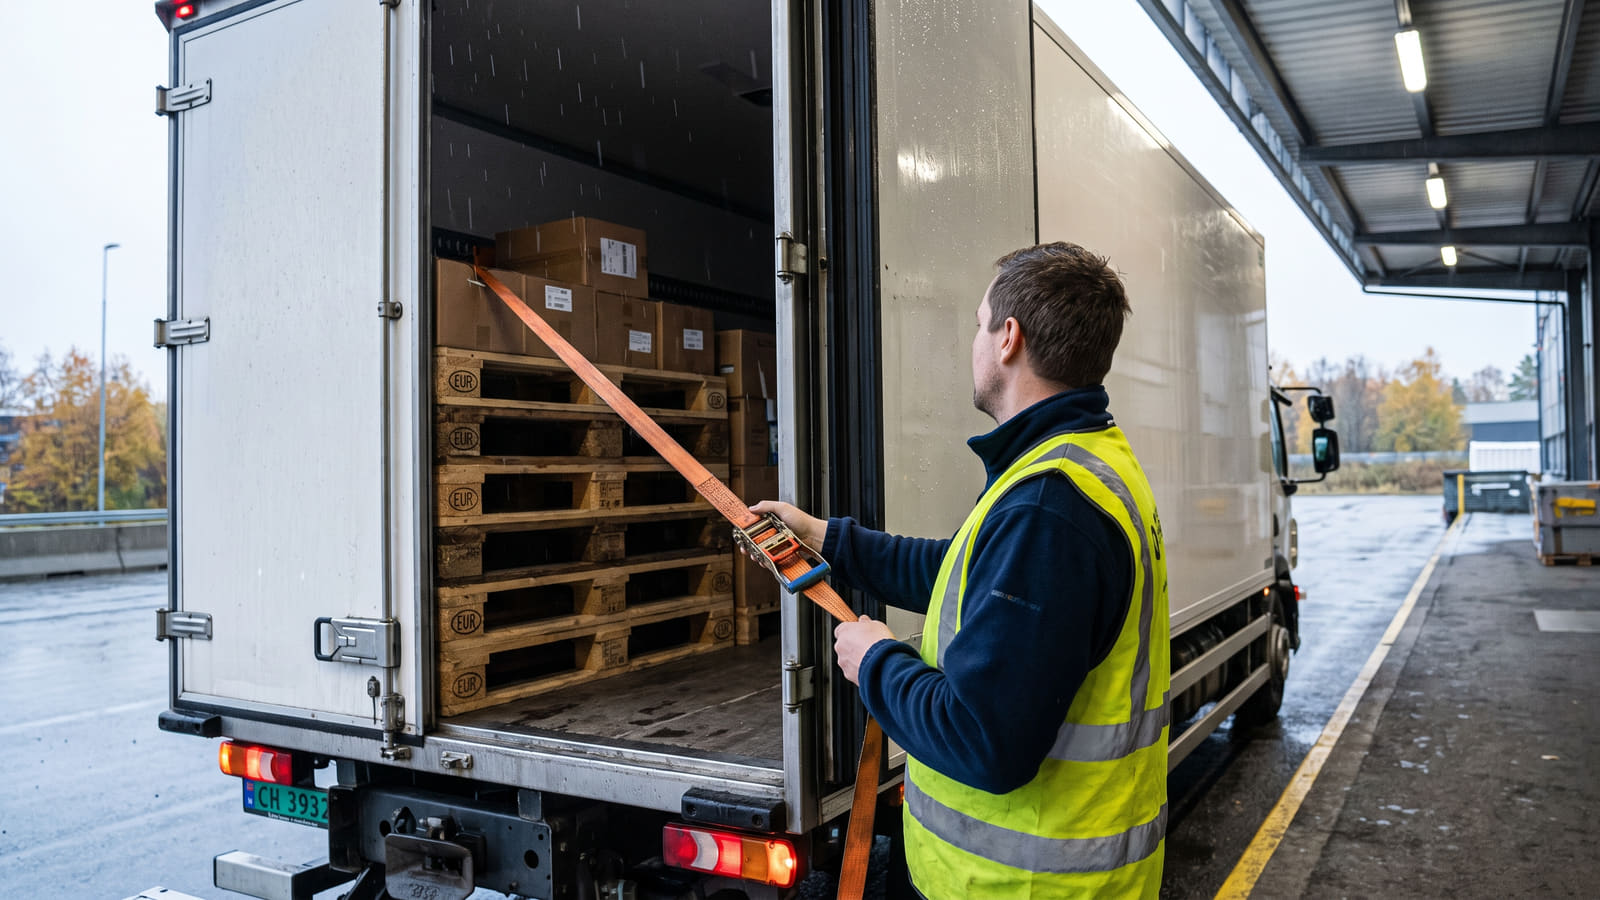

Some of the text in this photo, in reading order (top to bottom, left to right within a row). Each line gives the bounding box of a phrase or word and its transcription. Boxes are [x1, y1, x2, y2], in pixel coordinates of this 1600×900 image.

[454, 374, 473, 389] EUR
[454, 431, 473, 446] EUR
[453, 491, 473, 507] EUR
[457, 613, 476, 631] EUR
[457, 676, 477, 694] EUR
[258, 786, 280, 811] CH
